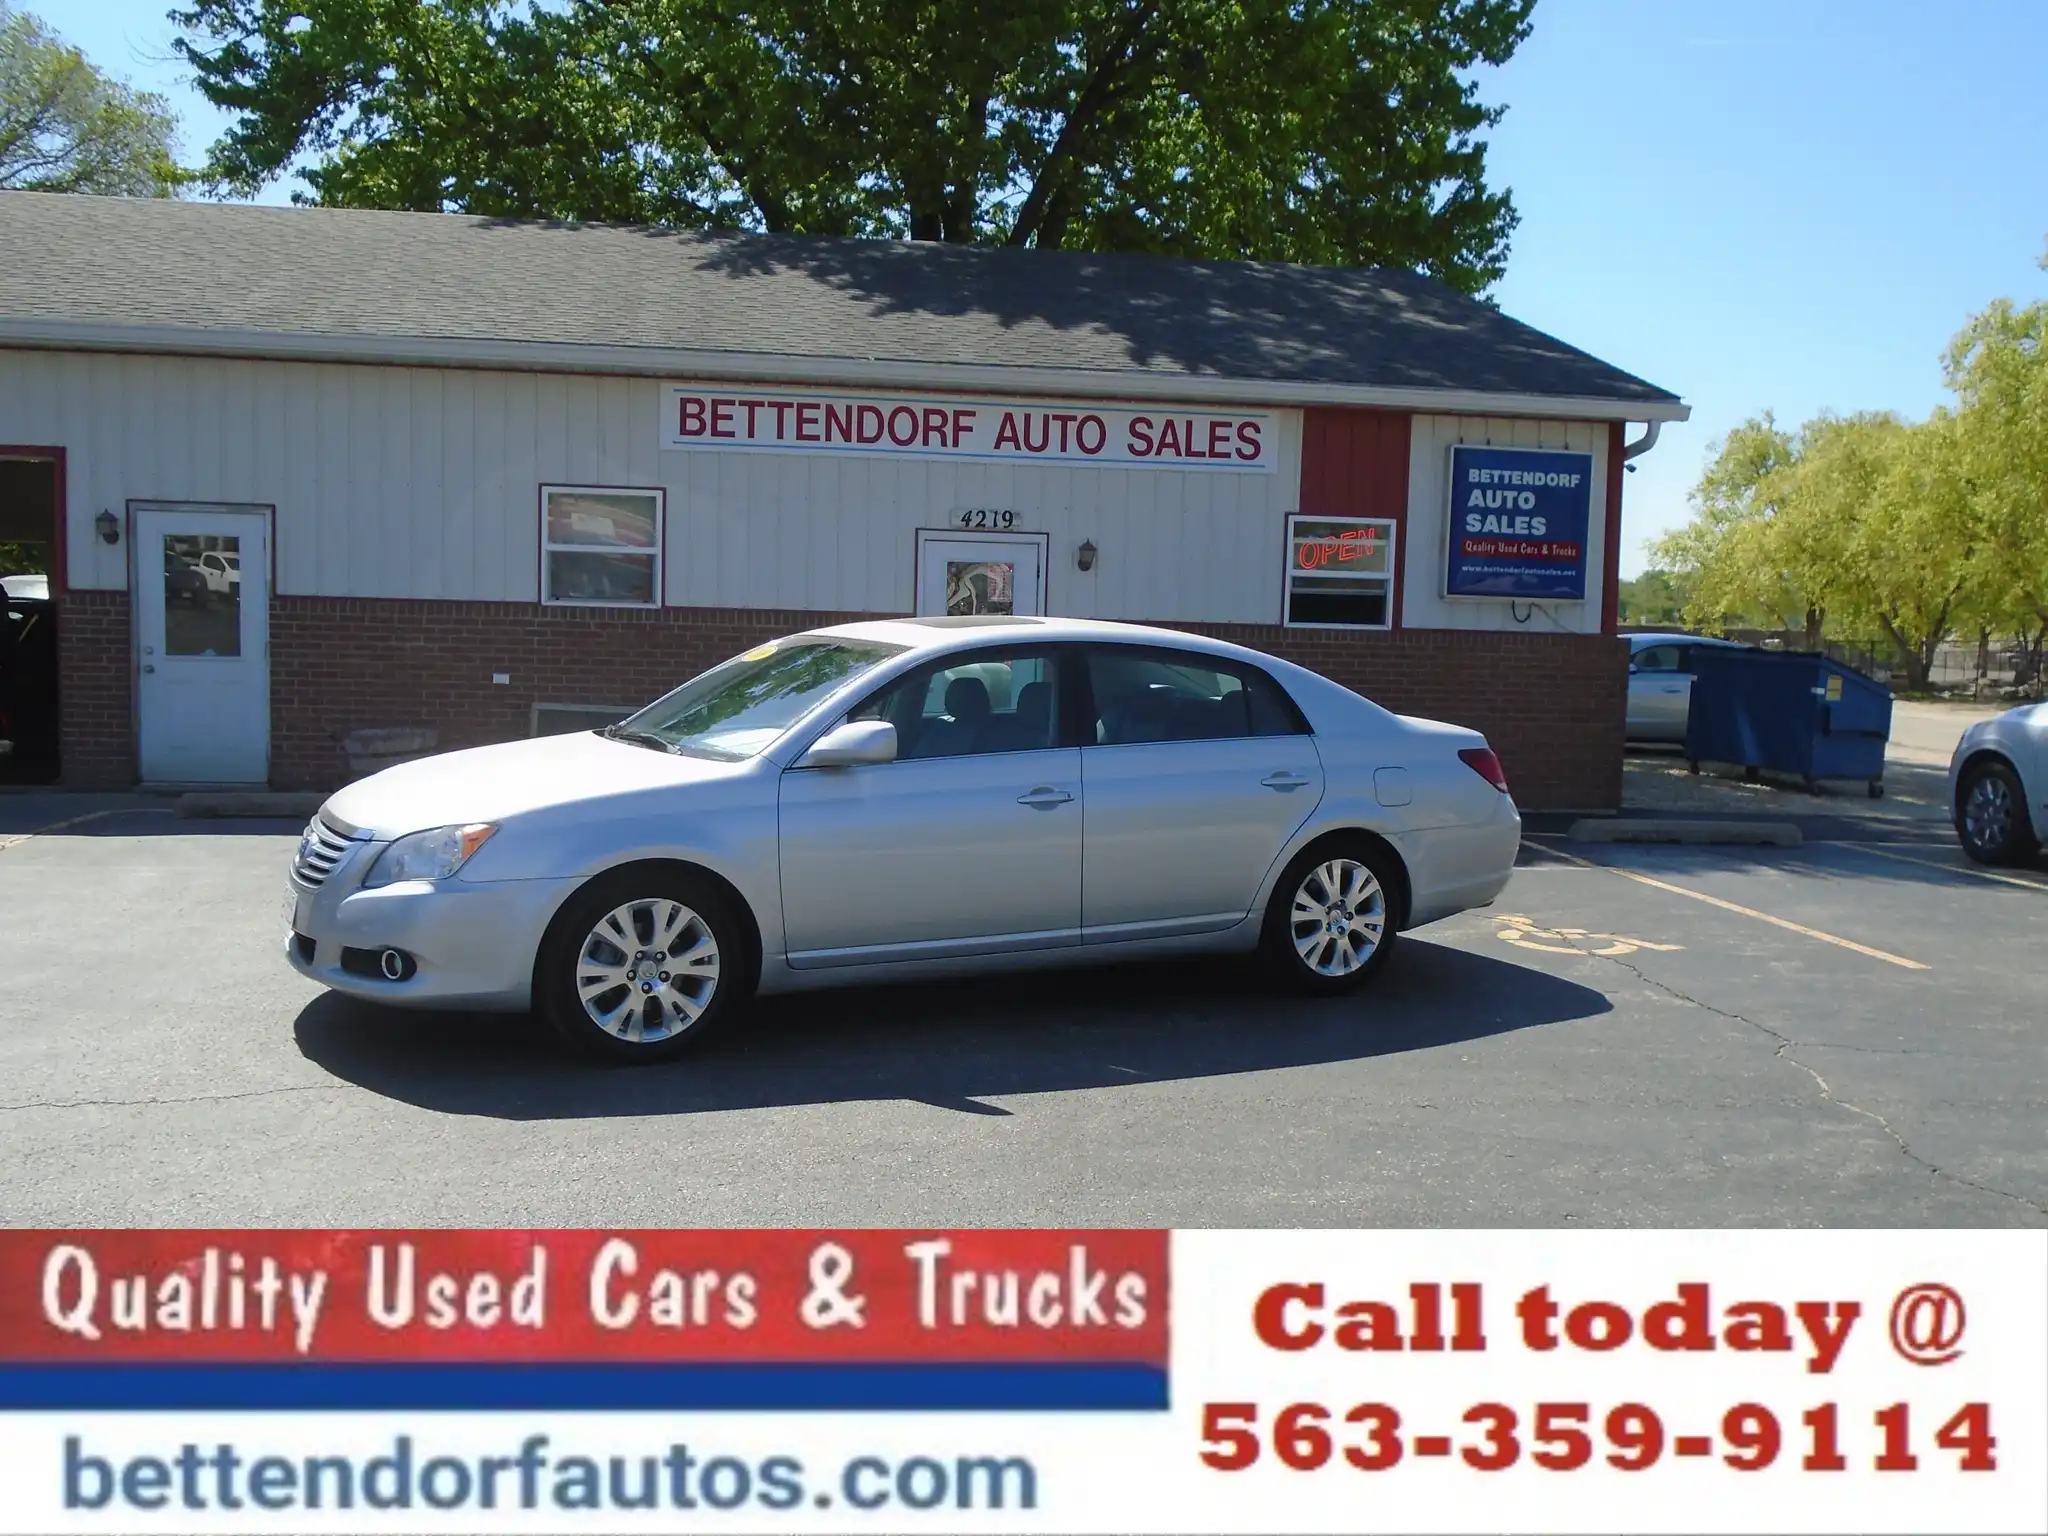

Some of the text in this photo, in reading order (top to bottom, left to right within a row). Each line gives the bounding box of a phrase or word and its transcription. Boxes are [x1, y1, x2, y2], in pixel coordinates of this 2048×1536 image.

[679, 396, 1263, 461] BETTENDORF AUTO SALES
[1468, 468, 1581, 487] BETTENDORF
[1467, 489, 1536, 510] AUTO
[960, 509, 1014, 529] 4219
[1466, 513, 1547, 535] SALES
[1299, 528, 1376, 570] OPEN
[1465, 540, 1576, 556] Quality Used Cars & Trucks
